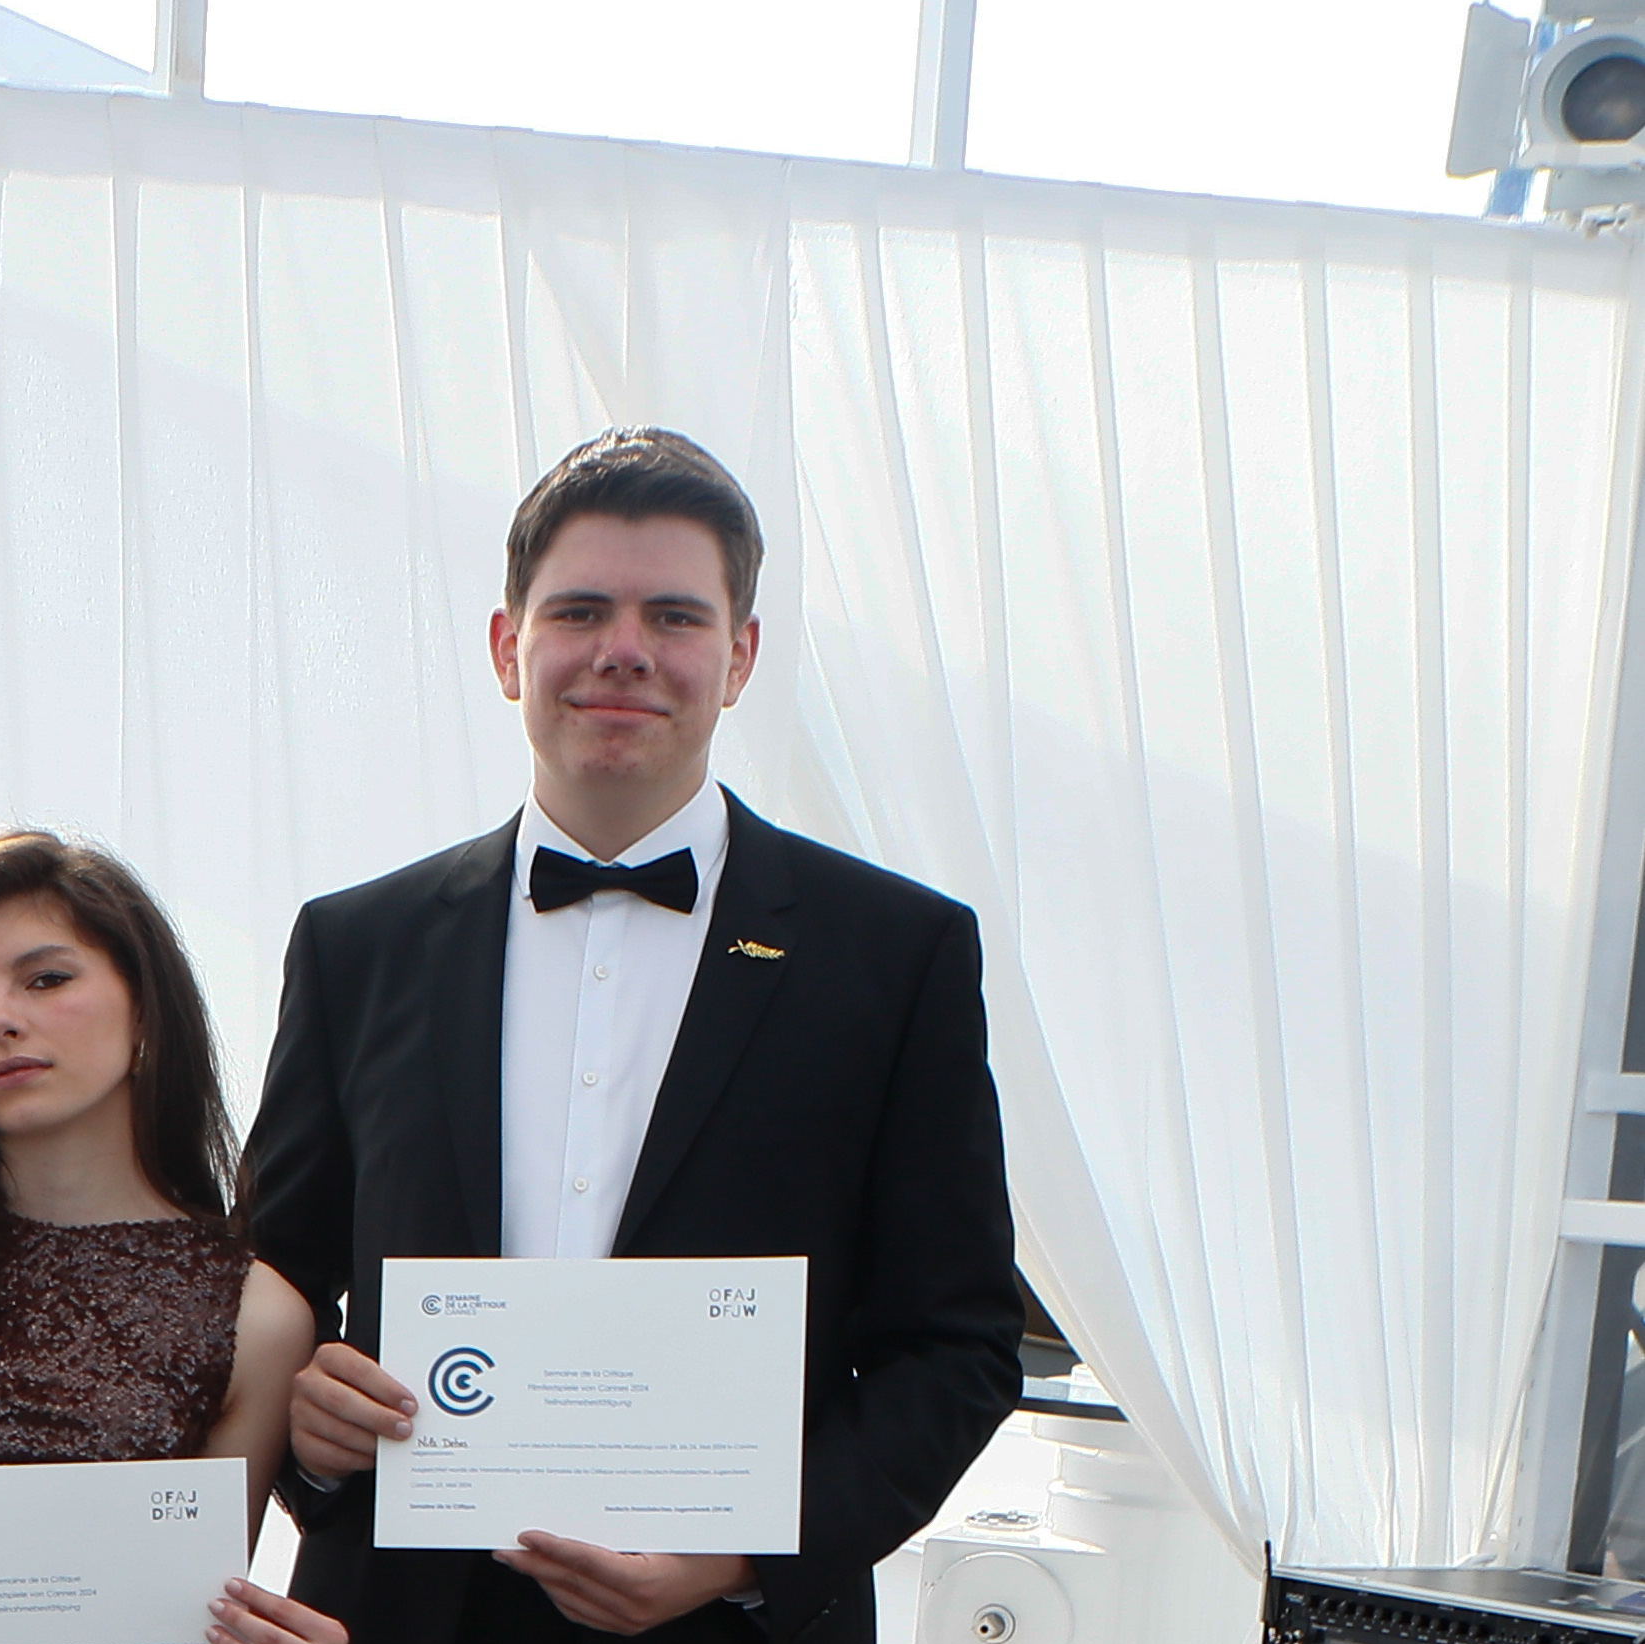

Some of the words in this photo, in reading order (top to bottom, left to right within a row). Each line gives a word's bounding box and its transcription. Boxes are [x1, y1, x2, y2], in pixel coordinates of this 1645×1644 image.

[709, 1289, 755, 1302] OFAJ
[710, 1305, 756, 1317] DFJW
[151, 1491, 196, 1504] OFAJ
[152, 1507, 198, 1520] DFJW
